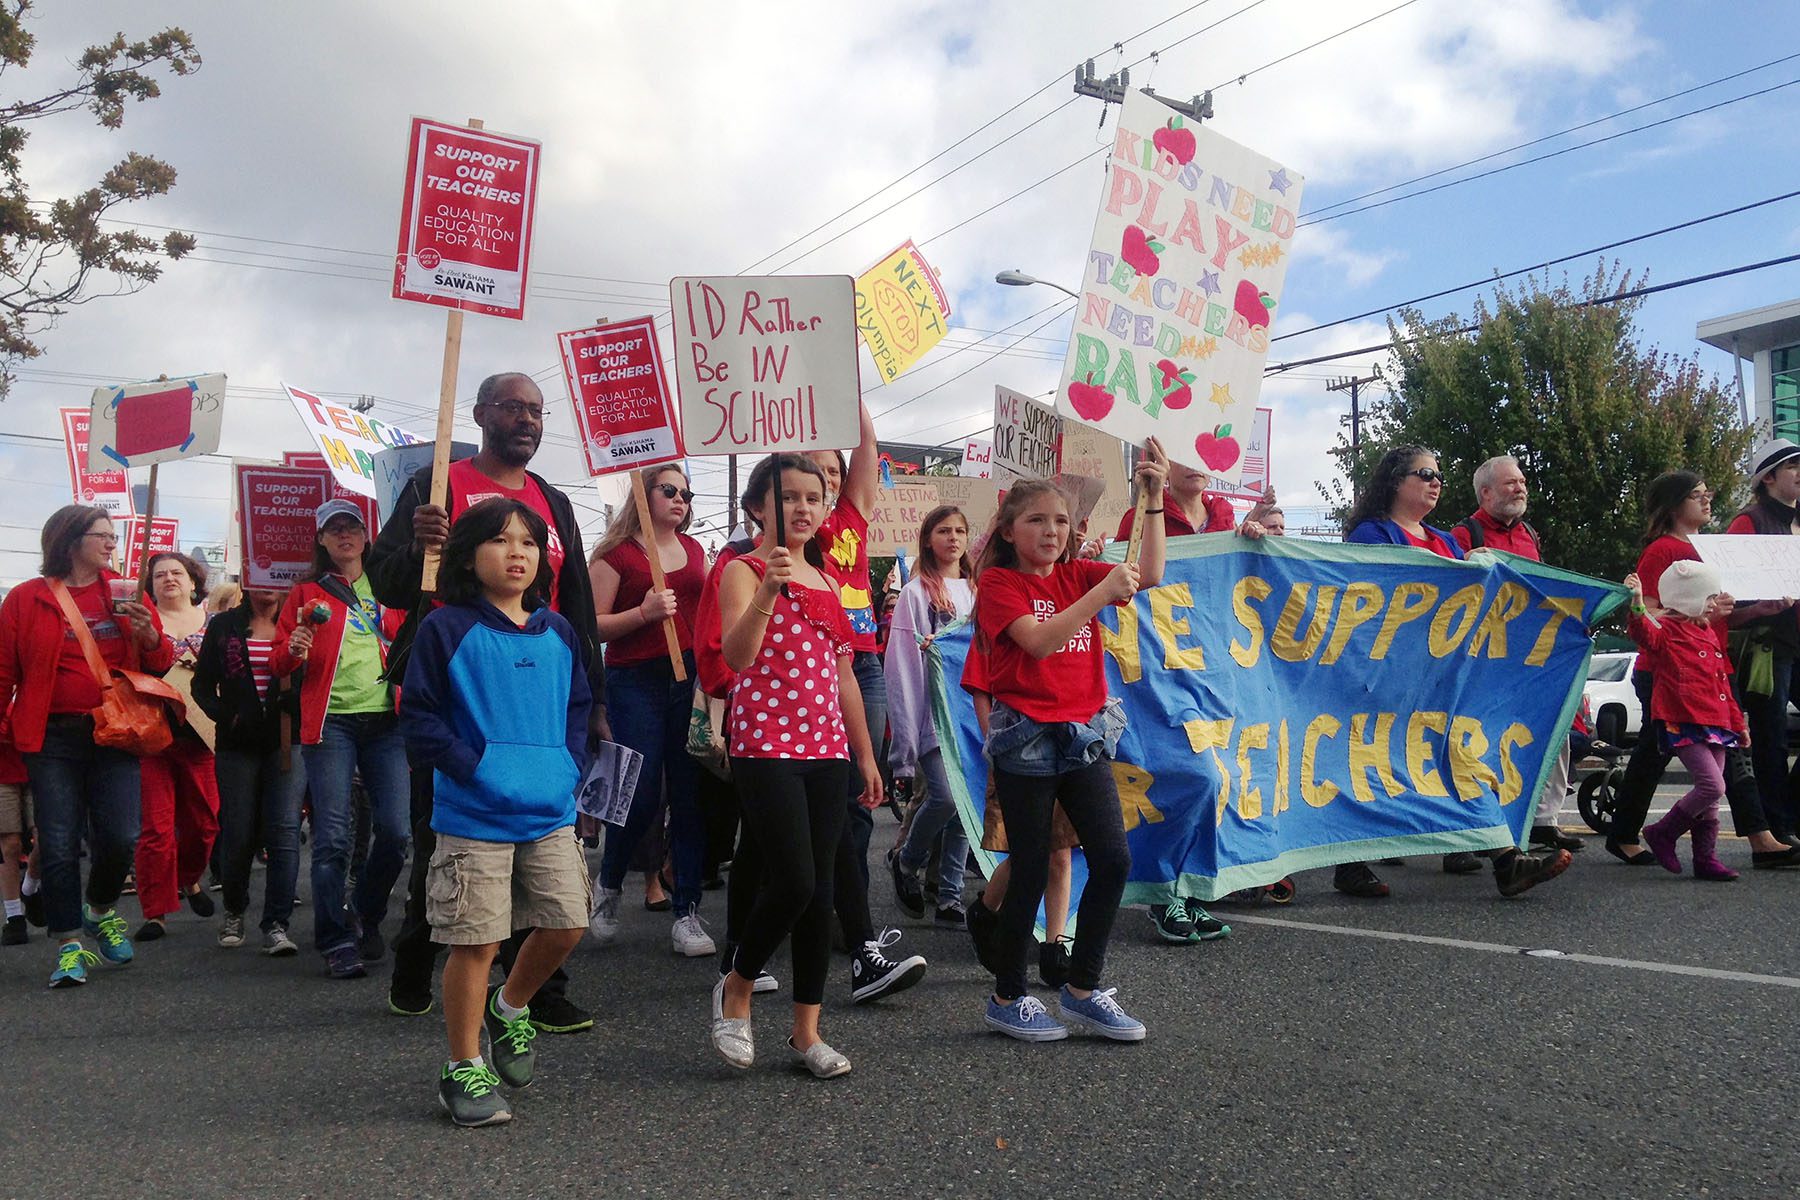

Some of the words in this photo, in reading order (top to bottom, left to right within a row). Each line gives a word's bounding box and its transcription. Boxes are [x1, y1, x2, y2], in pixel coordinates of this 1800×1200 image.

[434, 143, 520, 172] SUPPORT
[456, 165, 496, 184] OUR
[1113, 127, 1204, 192] KIDS
[1206, 173, 1298, 241] NEED
[427, 175, 522, 205] TEACHERS
[437, 205, 505, 226] QUALITY
[1105, 164, 1250, 272] PLAY
[424, 216, 515, 242] EDUCATION
[435, 233, 467, 246] FOR
[472, 239, 500, 254] ALL
[434, 274, 495, 295] SAWANT
[462, 272, 495, 285] KSHAMA
[894, 258, 941, 335] NEXT
[1091, 250, 1270, 354] TEACHERS
[685, 280, 726, 340] I'D
[739, 290, 822, 337] Rather
[879, 287, 916, 343] STOP
[855, 291, 897, 379] Olympia
[1081, 291, 1181, 359] NEED
[580, 338, 643, 359] SUPPORT
[599, 354, 629, 369] OUR
[691, 342, 729, 384] Be
[752, 344, 790, 384] IN
[581, 363, 653, 385] TEACHERS
[1070, 332, 1192, 421] PAY
[589, 396, 658, 416] EDUCATION
[595, 387, 646, 404] QUALITY
[288, 386, 424, 449] TEACHE
[601, 412, 625, 425] FOR
[628, 409, 650, 421] ALL
[1000, 394, 1019, 425] WE
[610, 442, 656, 458] SAWANT
[629, 437, 654, 446] KSHAMA
[994, 424, 1015, 463] OUR
[966, 443, 991, 464] End
[382, 454, 420, 484] We
[88, 476, 104, 484] FOR
[106, 476, 118, 484] ALL
[255, 483, 316, 495] SUPPORT
[272, 495, 300, 506] OUR
[893, 488, 937, 503] TESTING
[263, 524, 311, 534] QUALITY
[868, 528, 885, 542] ND
[134, 543, 172, 551] TECHERS
[265, 543, 288, 551] FOR
[1031, 599, 1056, 613] IDS
[1229, 575, 1588, 670] SUPPORT
[1068, 638, 1091, 653] PAY
